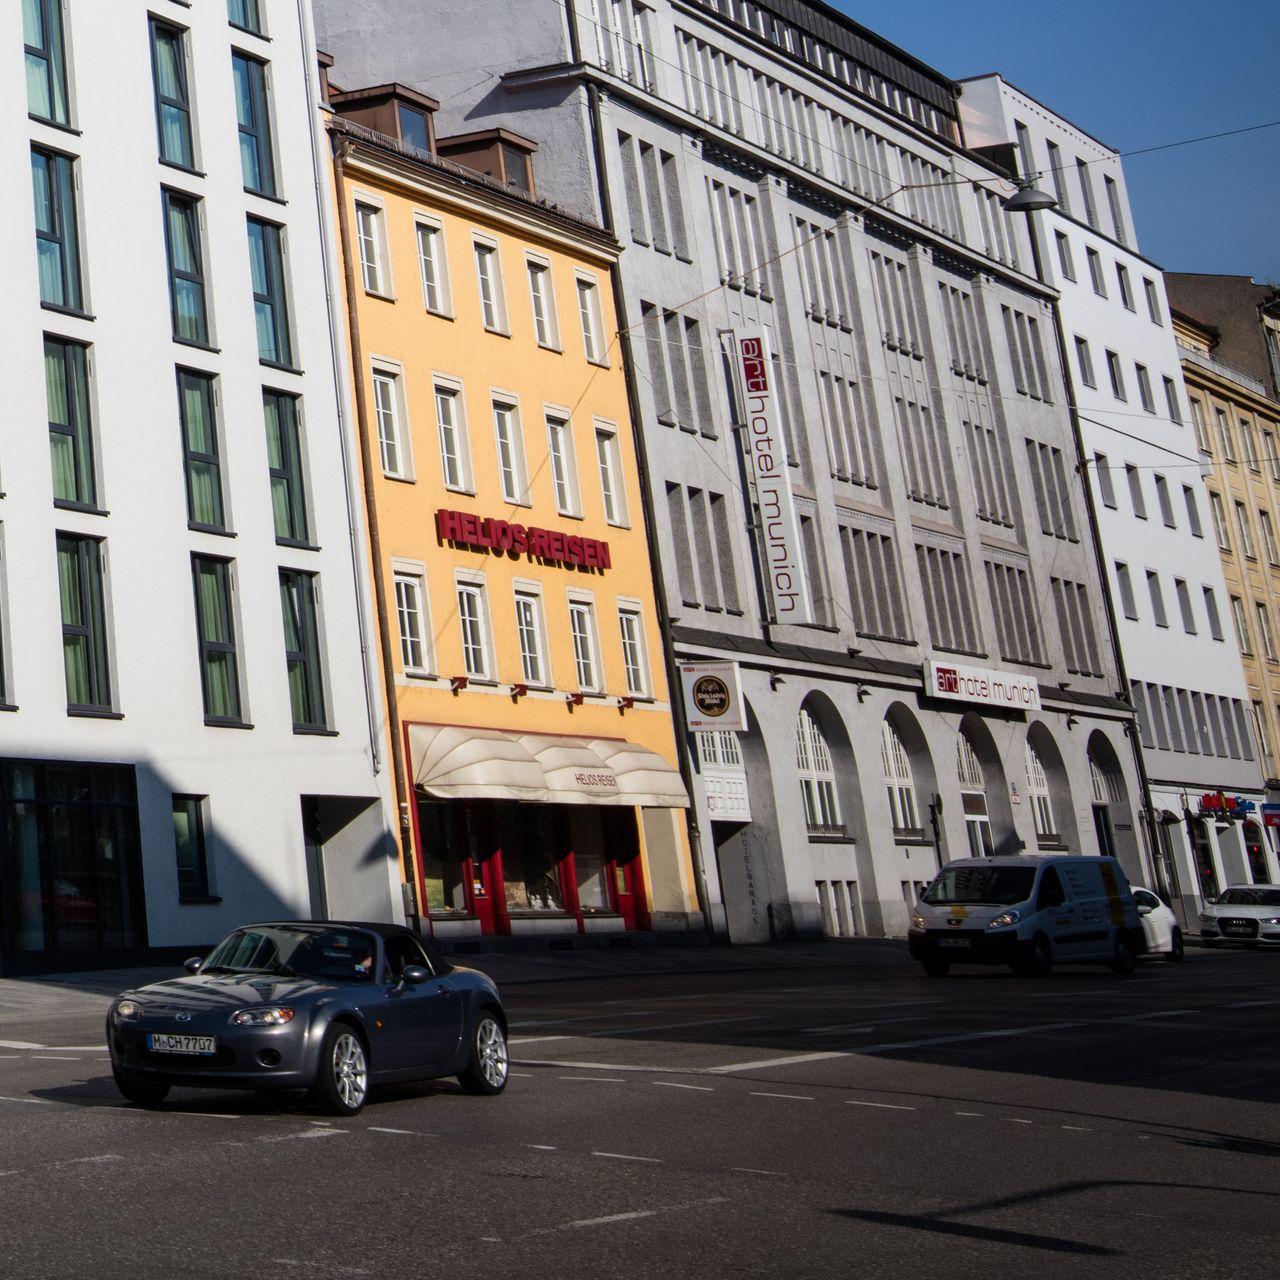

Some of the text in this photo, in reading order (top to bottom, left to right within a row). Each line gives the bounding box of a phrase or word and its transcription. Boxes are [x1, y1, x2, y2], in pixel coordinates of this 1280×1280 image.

[438, 508, 612, 570] HELIOS REISEN
[762, 486, 799, 613] munich
[993, 681, 1037, 705] munich
[153, 1035, 212, 1051] M CH 7707
